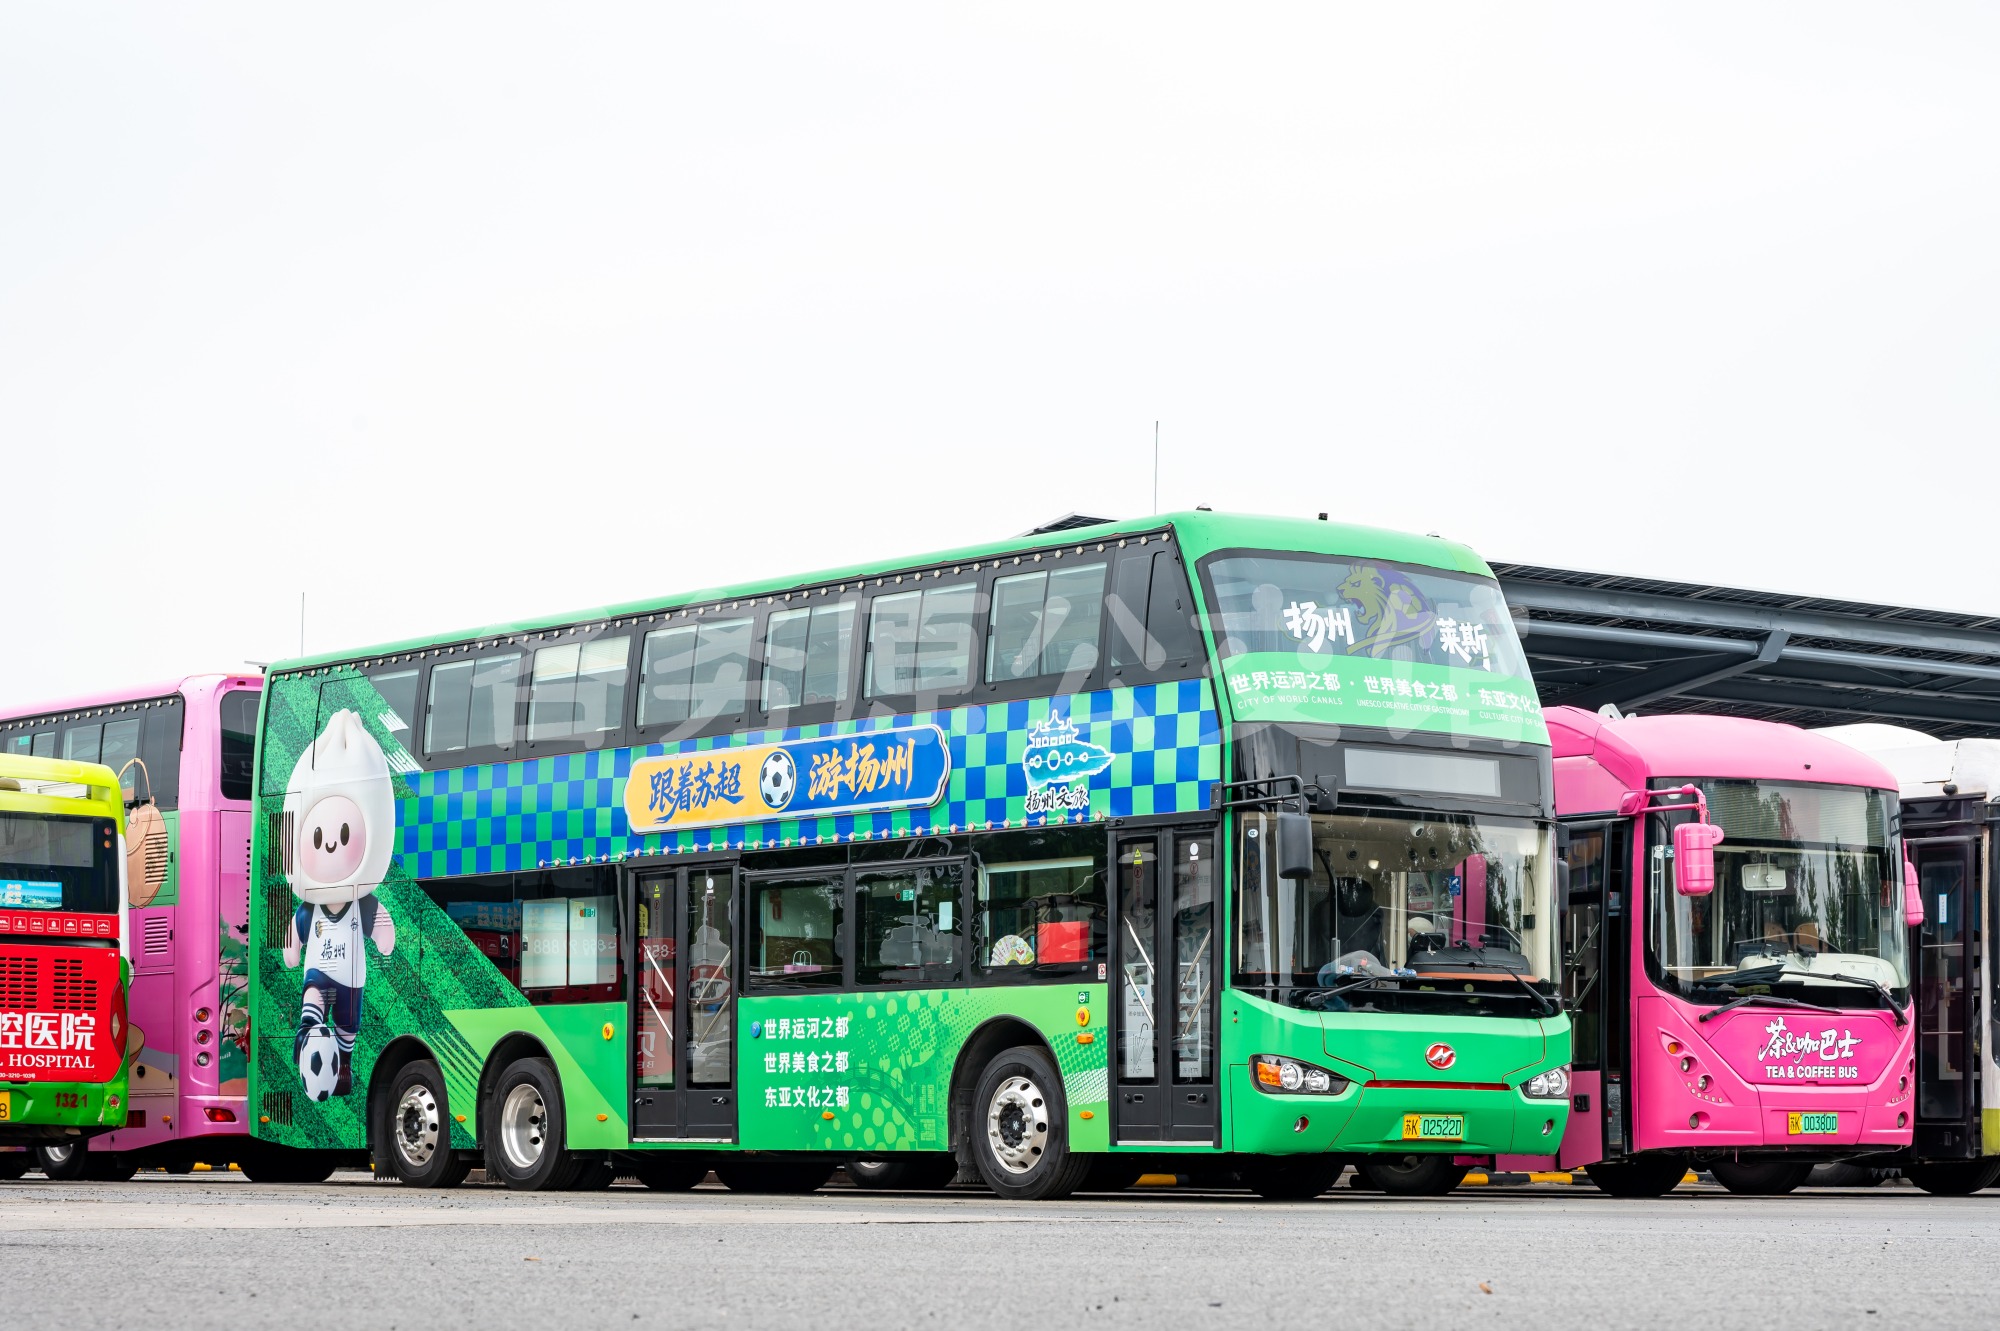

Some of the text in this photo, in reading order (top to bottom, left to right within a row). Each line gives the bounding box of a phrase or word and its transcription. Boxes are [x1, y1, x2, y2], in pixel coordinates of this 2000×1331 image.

[1283, 601, 1491, 672] 扬州 莱斯
[1230, 671, 1341, 695] 世界运河之都
[1364, 675, 1458, 702] 世界美食之都
[1237, 695, 1343, 710] CITY OF WORLD CANALS
[1356, 698, 1382, 708] UNESCO
[1382, 700, 1410, 711] CREATIVE
[1410, 703, 1423, 711] CITY
[1479, 711, 1509, 721] CULTURE
[1510, 715, 1524, 723] CITY
[648, 738, 916, 824] 跟着苏超 游扬州
[1026, 785, 1088, 812] 扬州文旅
[764, 1016, 849, 1039] 世界运河之都
[8, 1054, 95, 1068] HOSPITAL
[764, 1050, 849, 1073] 世界美食之都
[1765, 1065, 1858, 1078] TEA & COFFEE BUS
[55, 1092, 88, 1109] 1321
[764, 1085, 850, 1108] 东亚文化之都
